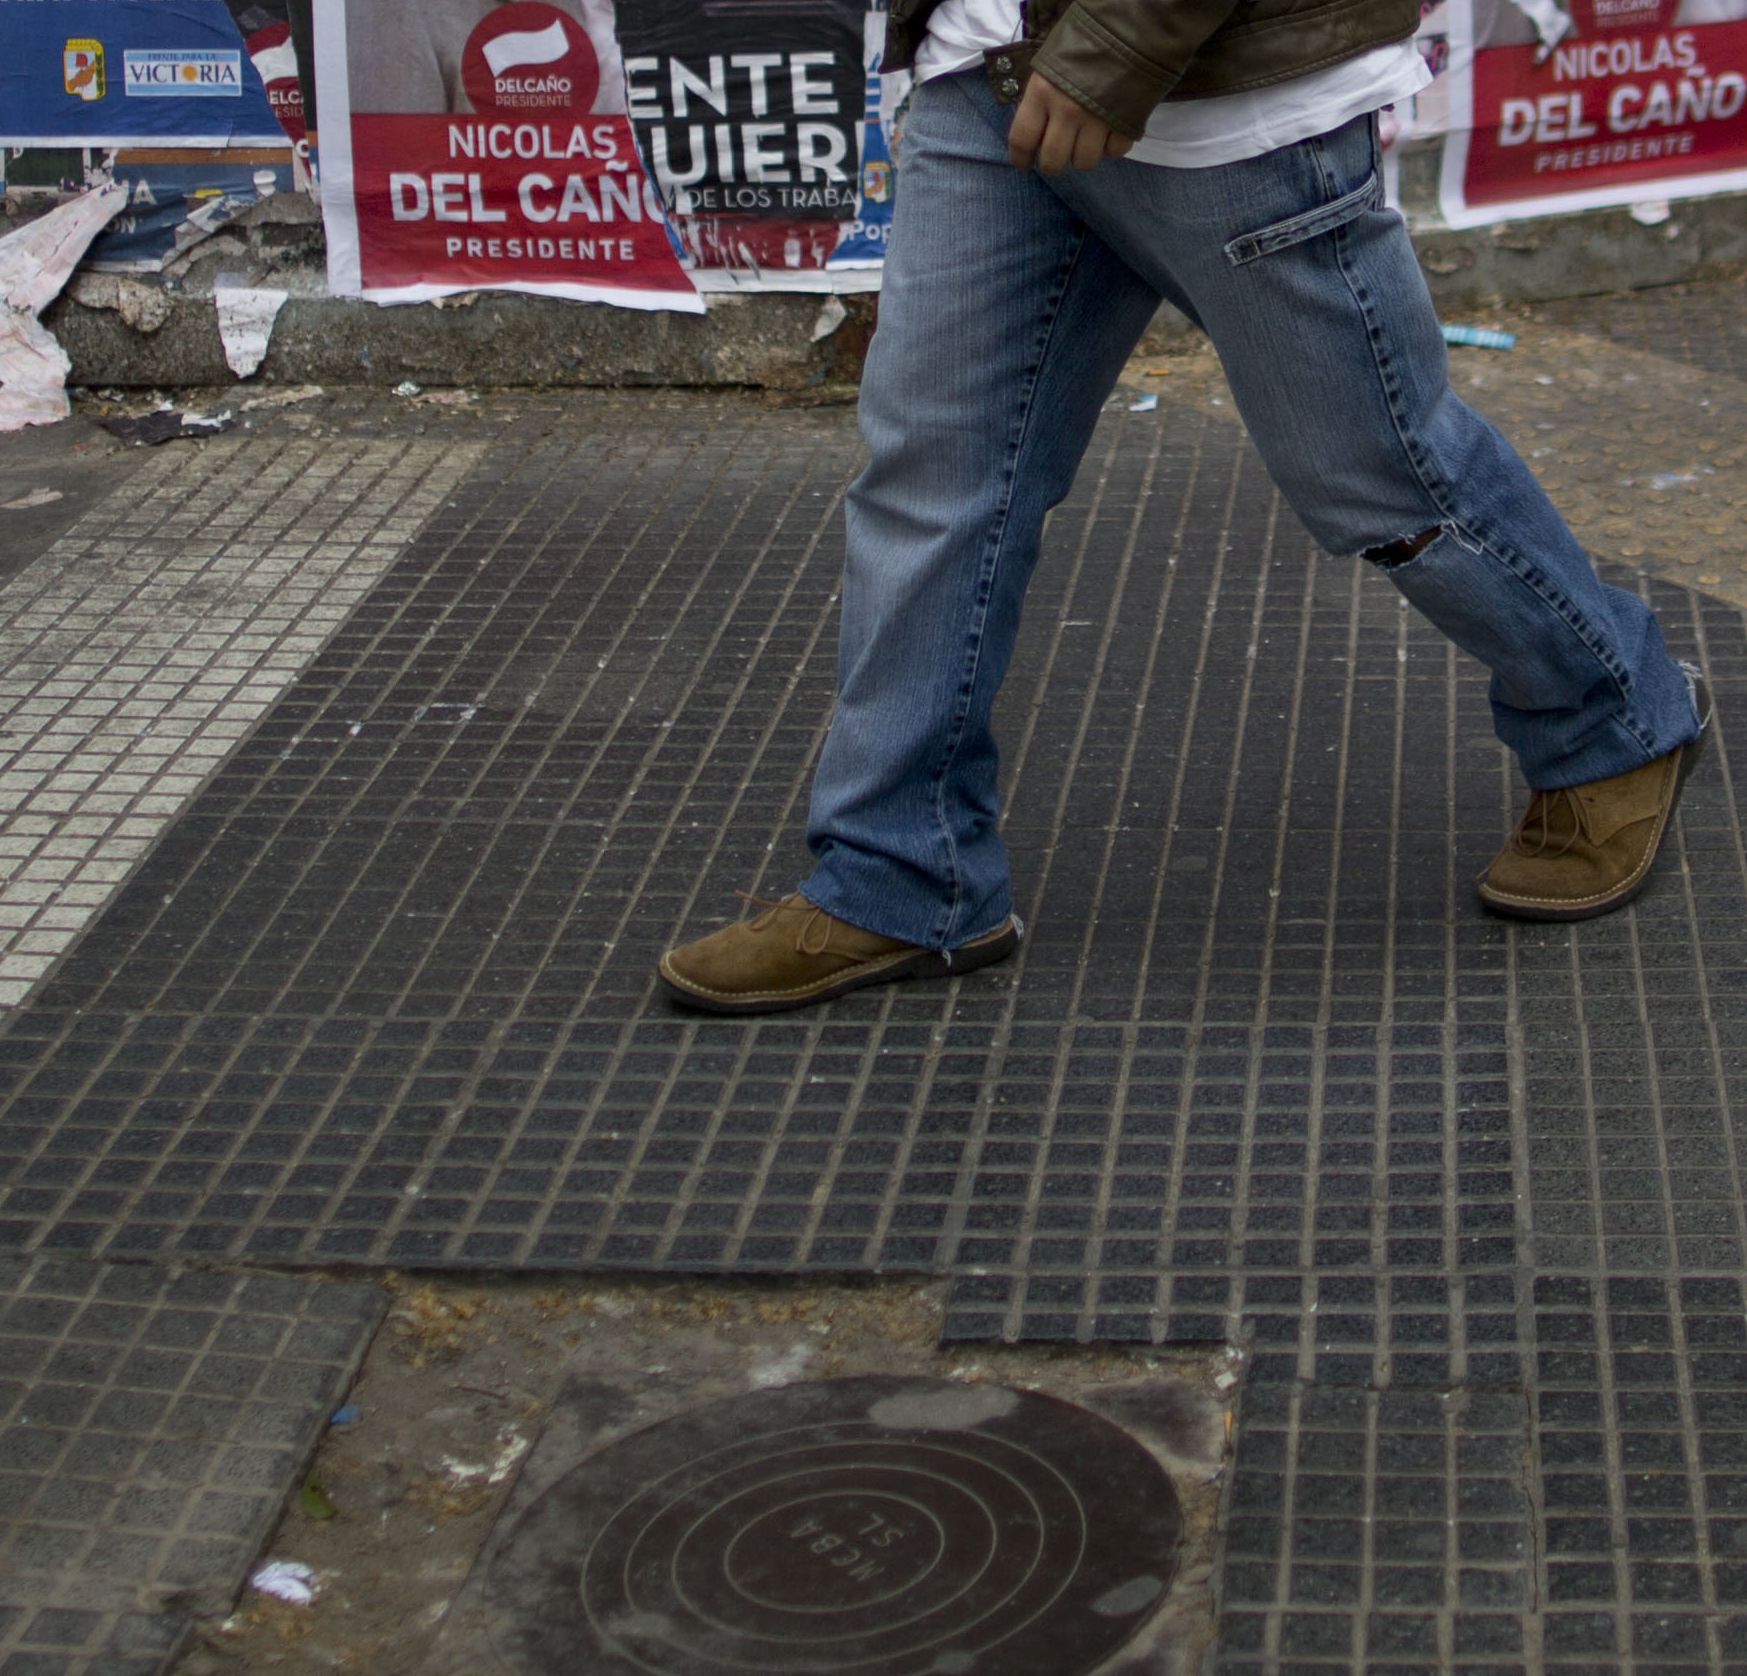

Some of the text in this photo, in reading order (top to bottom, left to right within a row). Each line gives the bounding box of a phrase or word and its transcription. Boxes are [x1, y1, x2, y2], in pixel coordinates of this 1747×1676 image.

[1553, 33, 1697, 81] NICOLAS
[494, 74, 572, 93] DELCAÑO
[495, 92, 572, 108] PRESIDENTE
[1497, 66, 1747, 147] DEL CAÑO
[448, 123, 619, 162] NICOLAS
[1534, 132, 1695, 174] PRESIDENTE
[389, 173, 508, 223] DEL
[724, 187, 772, 209] LOS
[446, 237, 635, 262] PRESIDENTE
